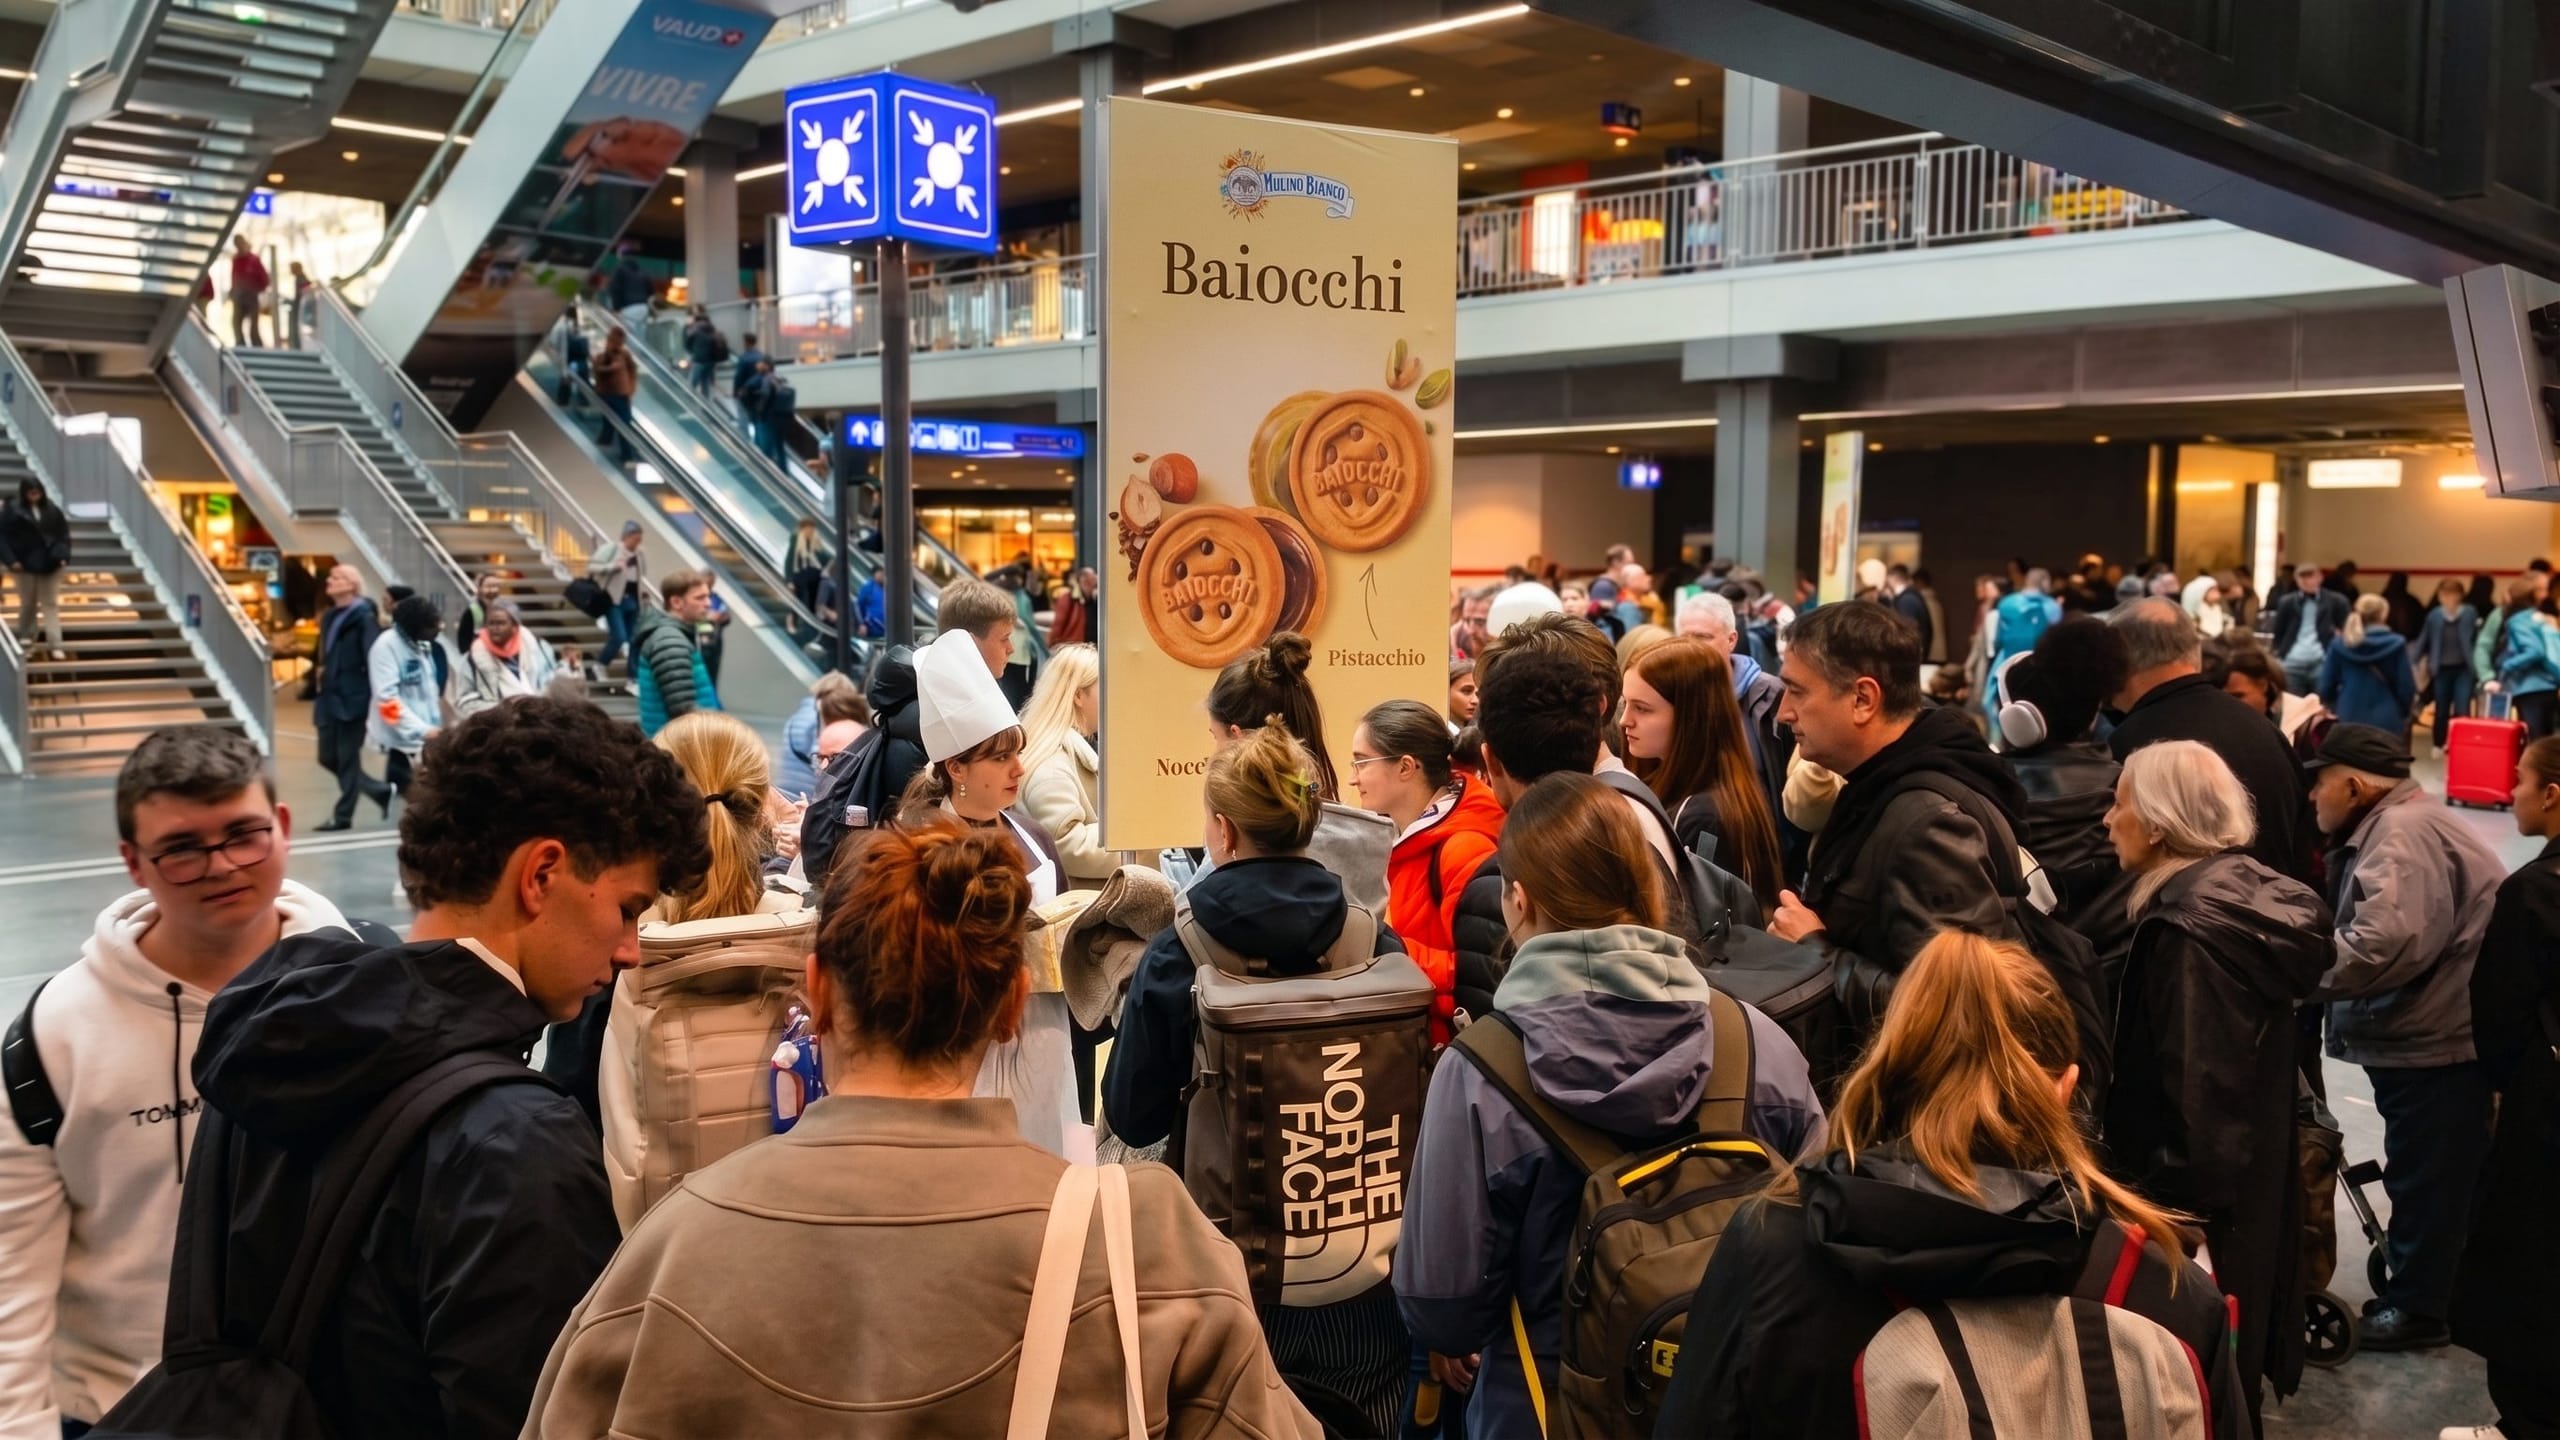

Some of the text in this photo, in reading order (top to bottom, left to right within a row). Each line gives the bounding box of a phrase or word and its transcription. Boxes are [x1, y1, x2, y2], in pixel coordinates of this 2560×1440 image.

[652, 15, 723, 42] VAUD
[590, 65, 708, 113] VIVRE
[1263, 173, 1346, 202] MULINO BIANCO
[1161, 241, 1406, 314] Baiocchi
[1312, 460, 1404, 496] BAIOCCHI
[1160, 575, 1257, 611] BAIOCCHI
[1327, 648, 1426, 667] Pistacchio
[1156, 757, 1210, 777] Nocc
[1321, 1042, 1366, 1229] NORTH
[1279, 1102, 1326, 1232] FACE
[1364, 1113, 1403, 1220] THE
